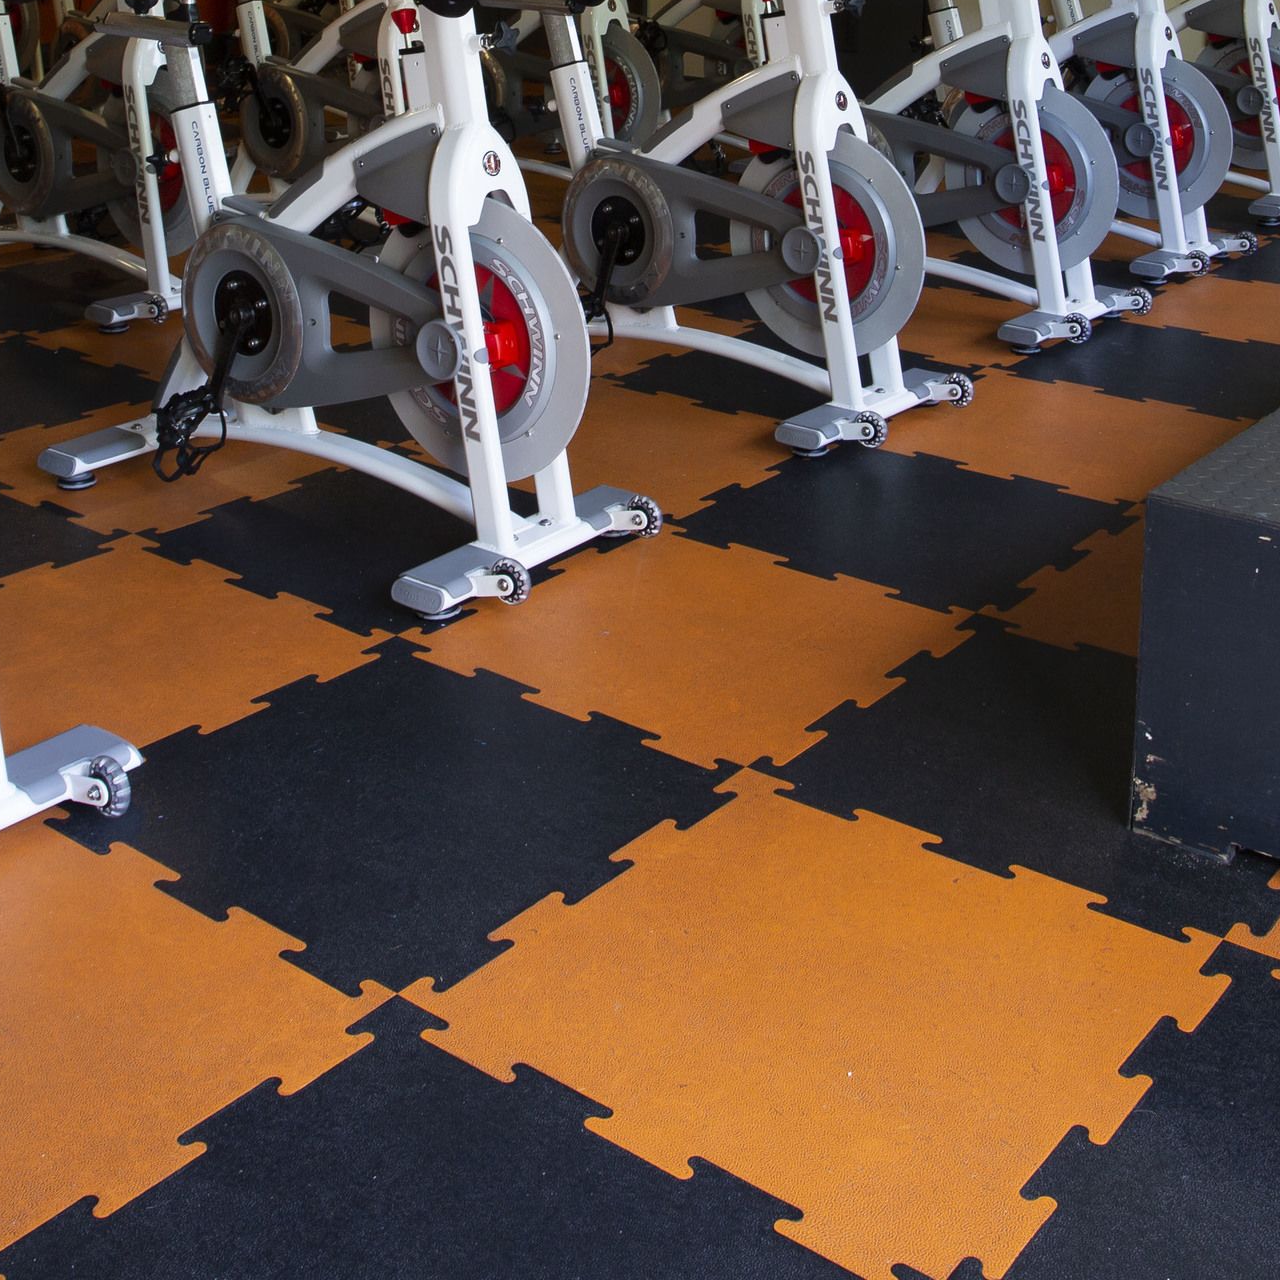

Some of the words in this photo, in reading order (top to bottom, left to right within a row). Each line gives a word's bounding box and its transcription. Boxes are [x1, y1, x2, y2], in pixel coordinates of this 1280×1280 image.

[570, 77, 583, 120] CARBON
[579, 123, 591, 153] BLUE
[192, 120, 207, 174] CARBON
[203, 177, 215, 213] BLUE
[491, 258, 545, 408] SCHWINN
